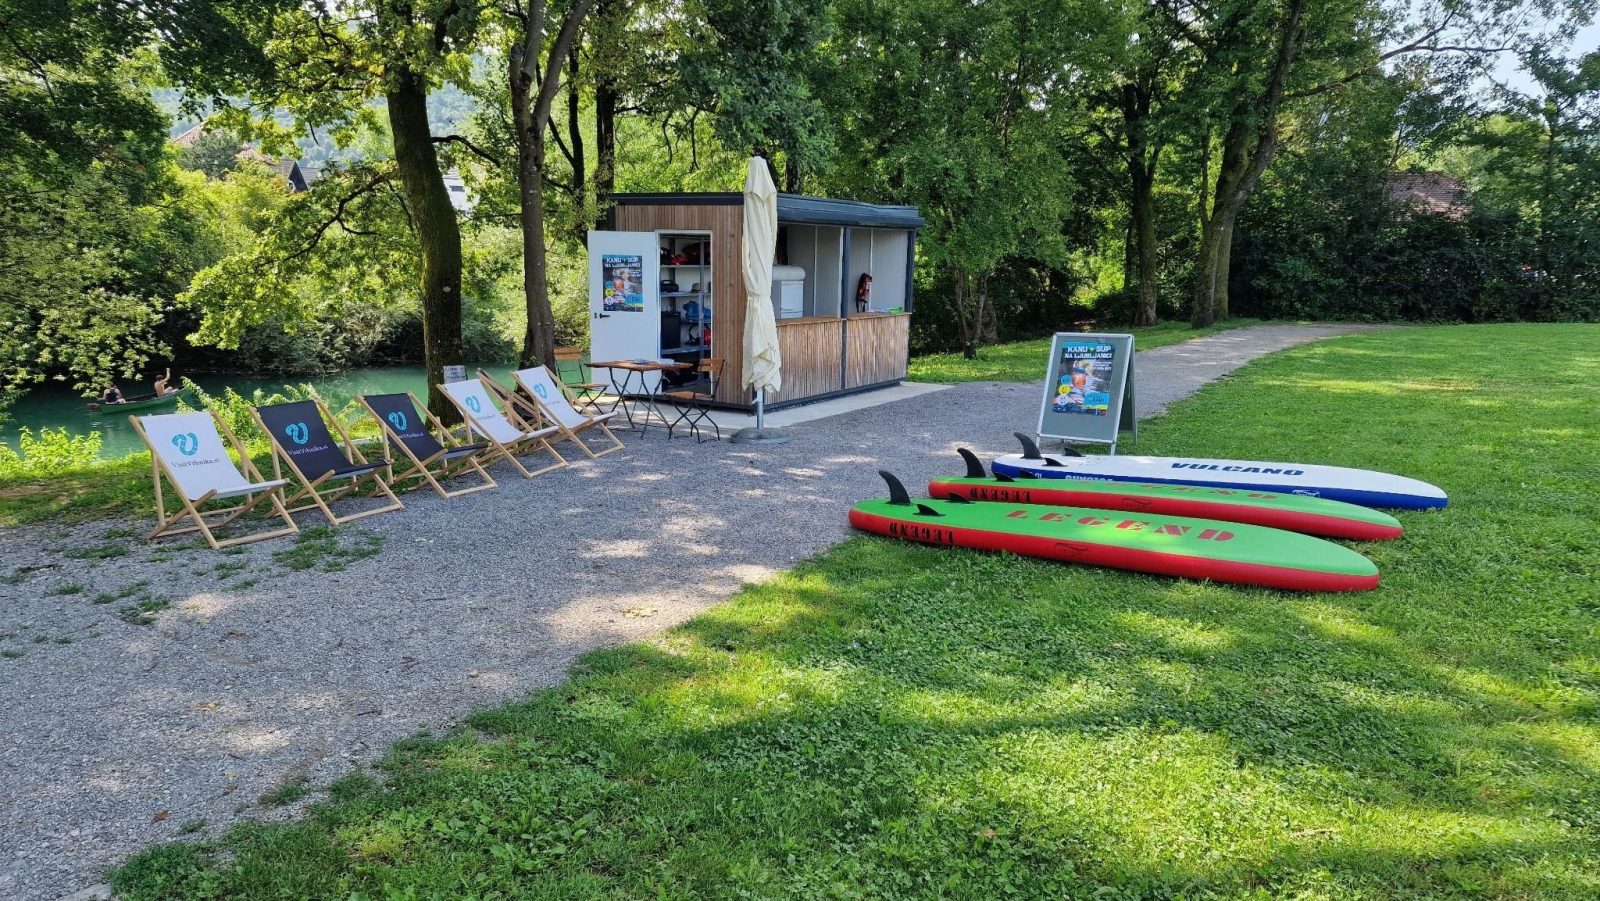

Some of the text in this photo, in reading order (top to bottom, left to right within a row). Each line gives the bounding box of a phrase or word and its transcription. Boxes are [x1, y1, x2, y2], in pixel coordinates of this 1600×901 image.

[1171, 462, 1305, 476] VULCANO
[970, 487, 1032, 503] LEGEND
[889, 521, 954, 545] LEGEND
[1005, 509, 1236, 542] LEGEND
